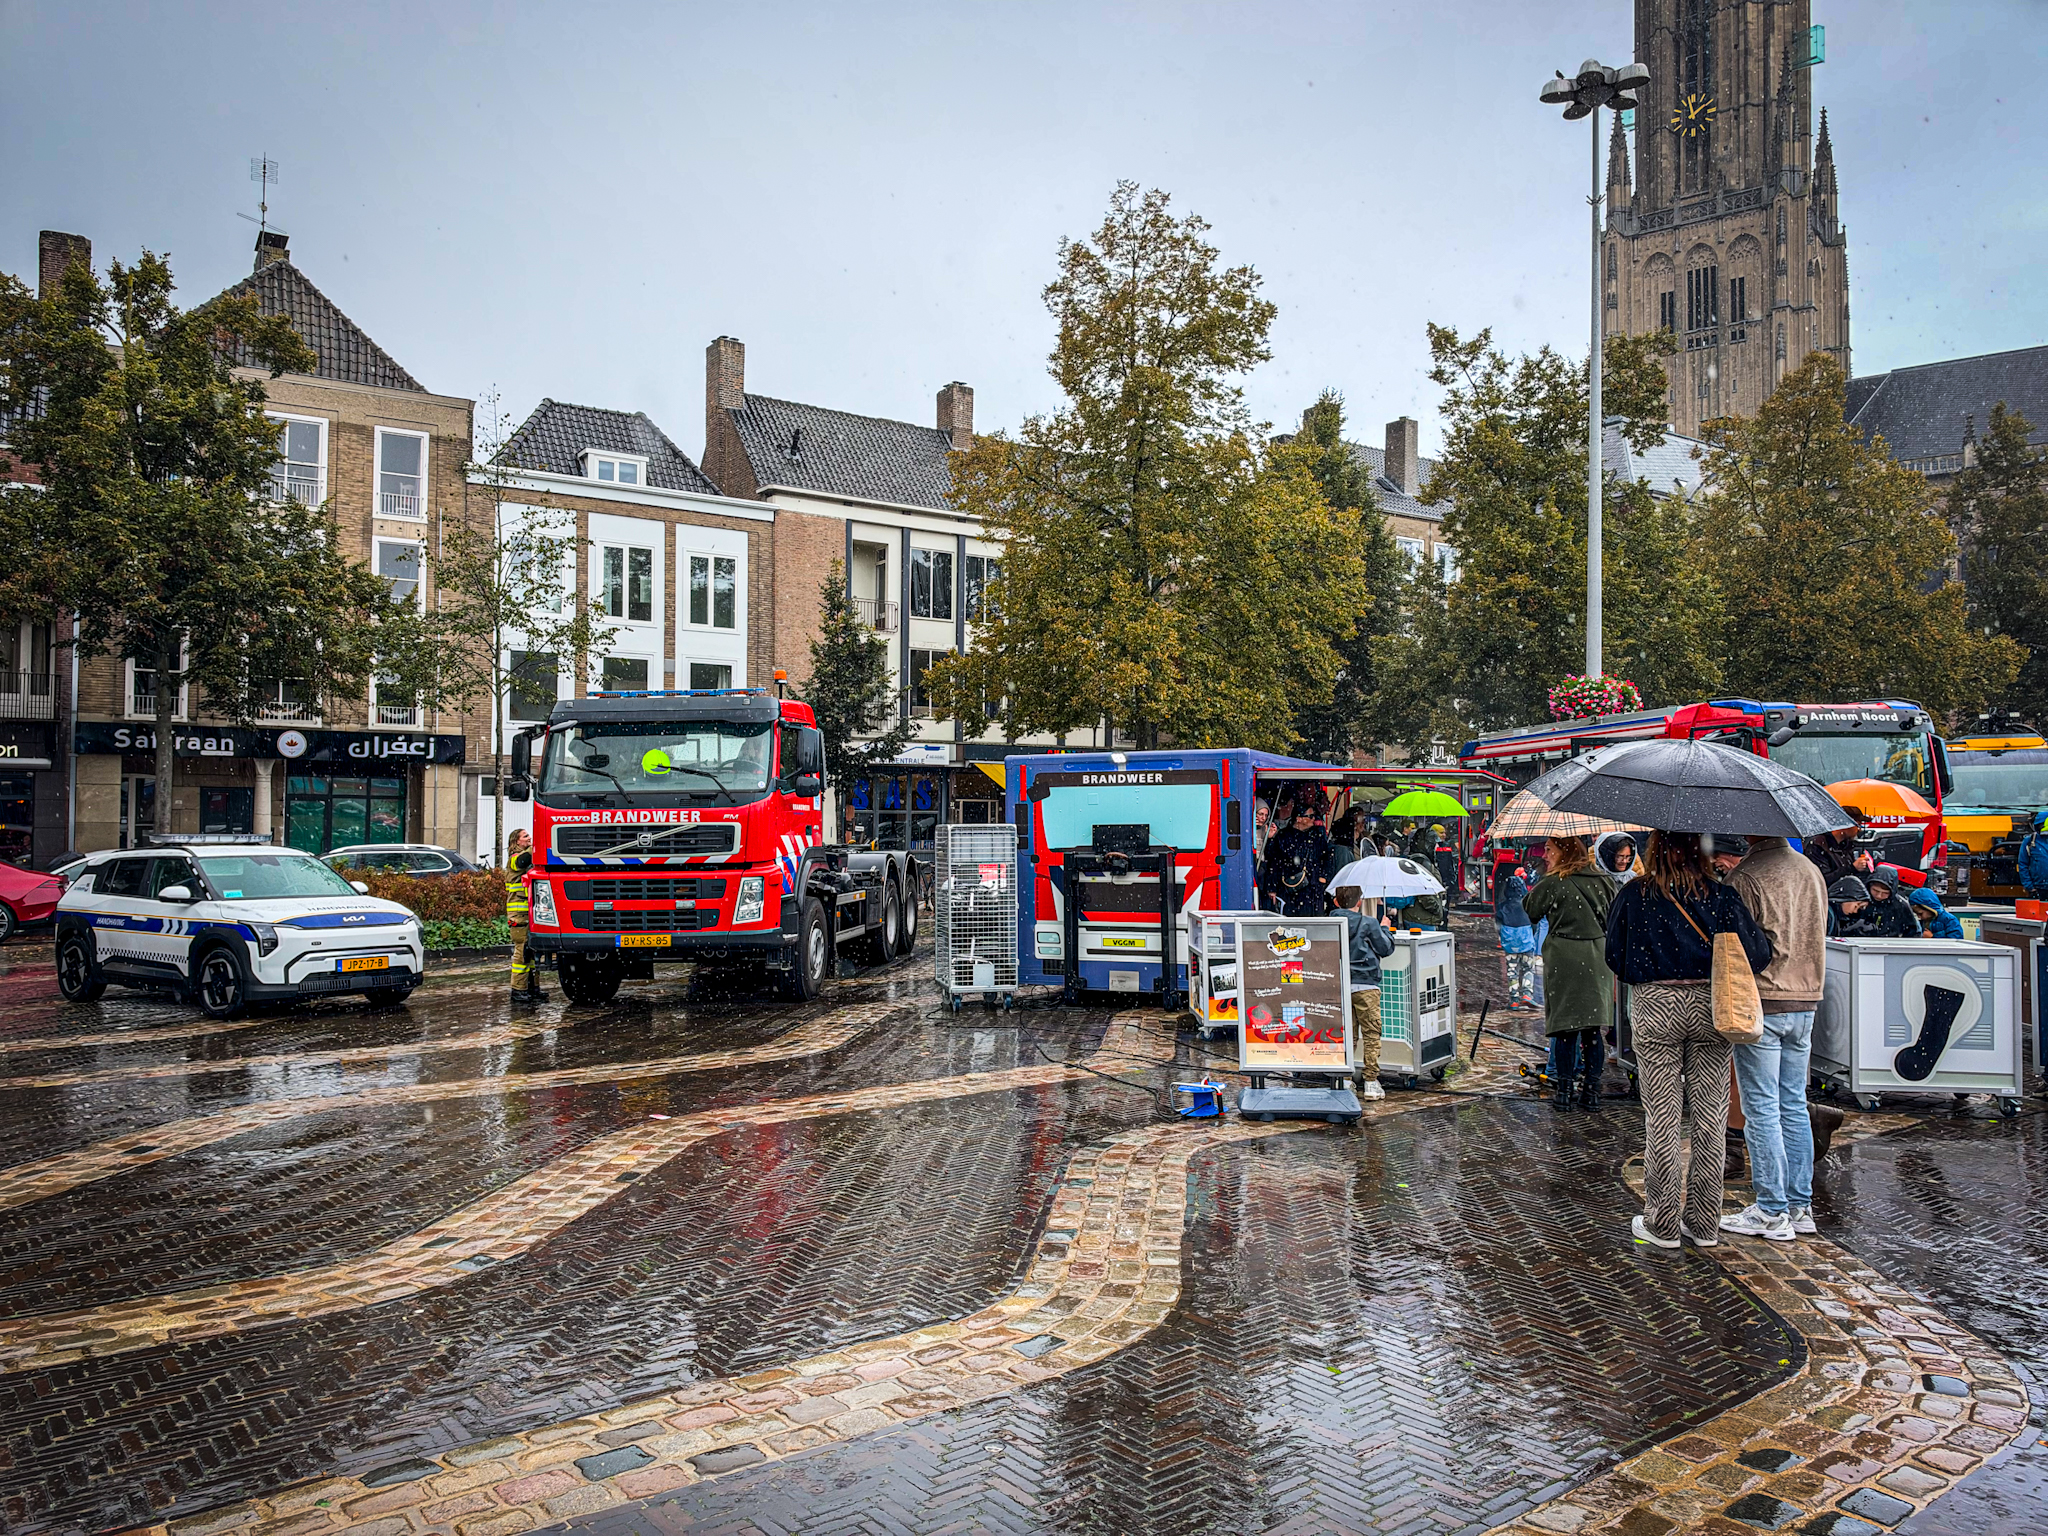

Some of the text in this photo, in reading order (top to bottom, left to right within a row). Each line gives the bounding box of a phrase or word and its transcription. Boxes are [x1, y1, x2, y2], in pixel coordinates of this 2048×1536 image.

[1810, 711, 1899, 722] Arnhem Noord
[114, 728, 235, 751] Safraan
[348, 735, 435, 759] زعفران
[1082, 773, 1163, 784] BRANDWEER
[590, 810, 701, 824] BRANDWEER
[96, 917, 126, 926] HANDHAVING
[623, 936, 668, 946] BV-RS-85
[1274, 942, 1288, 952] THE
[1287, 937, 1306, 949] GAME
[347, 958, 384, 970] JPZ-17-B
